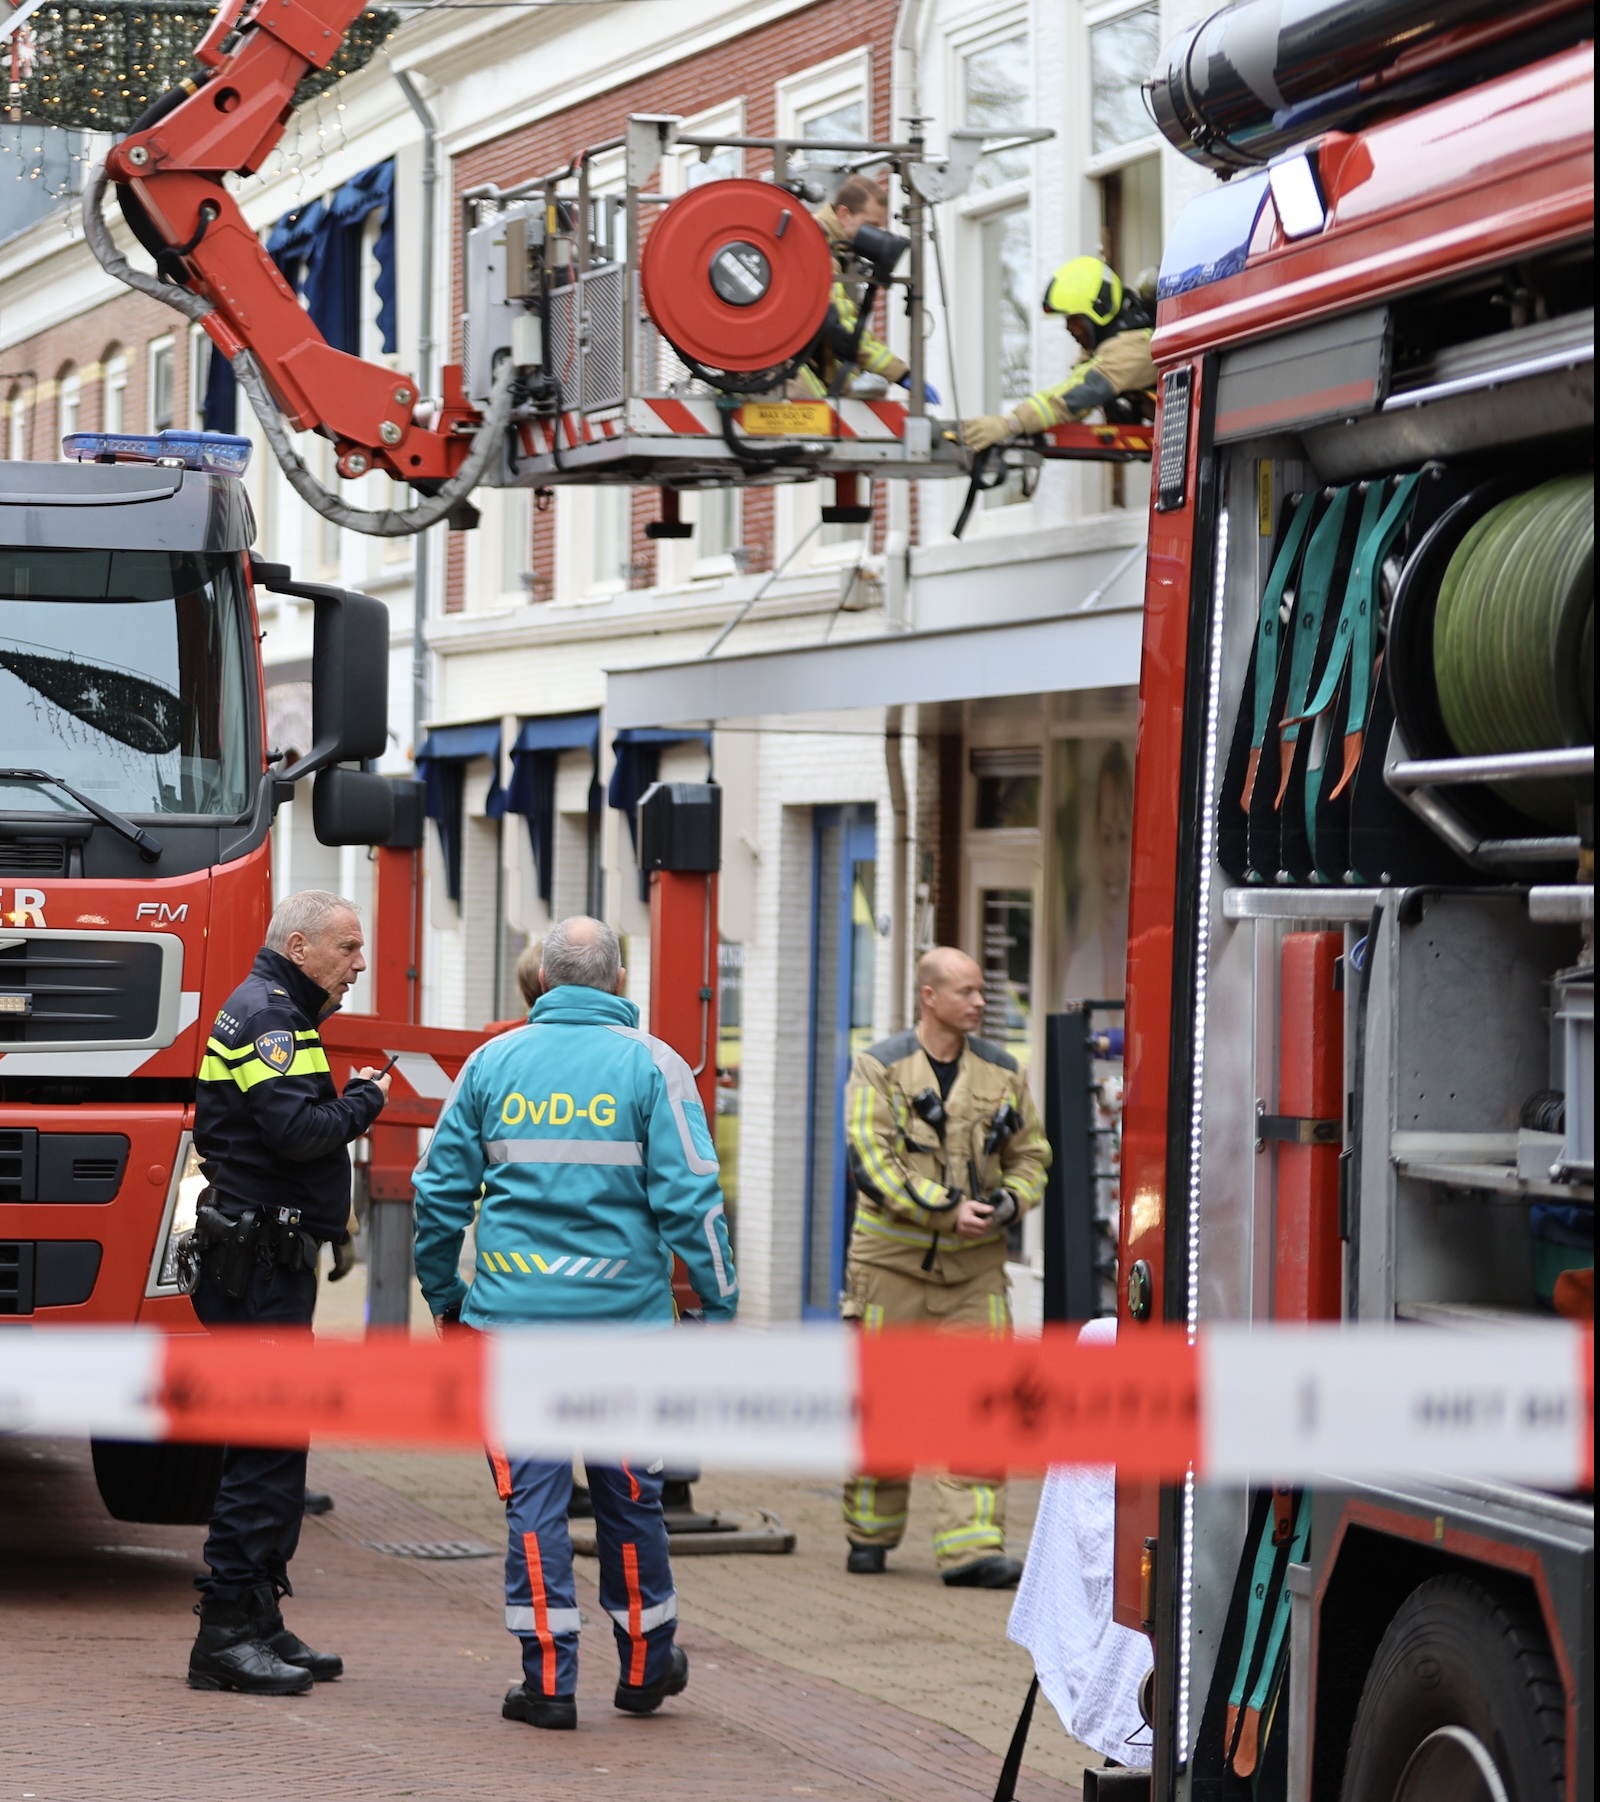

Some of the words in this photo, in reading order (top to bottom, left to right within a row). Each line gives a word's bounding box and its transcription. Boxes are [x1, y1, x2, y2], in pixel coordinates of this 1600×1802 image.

[135, 903, 190, 923] FM
[260, 1036, 289, 1047] POLITIE
[501, 1092, 617, 1127] OvD-G
